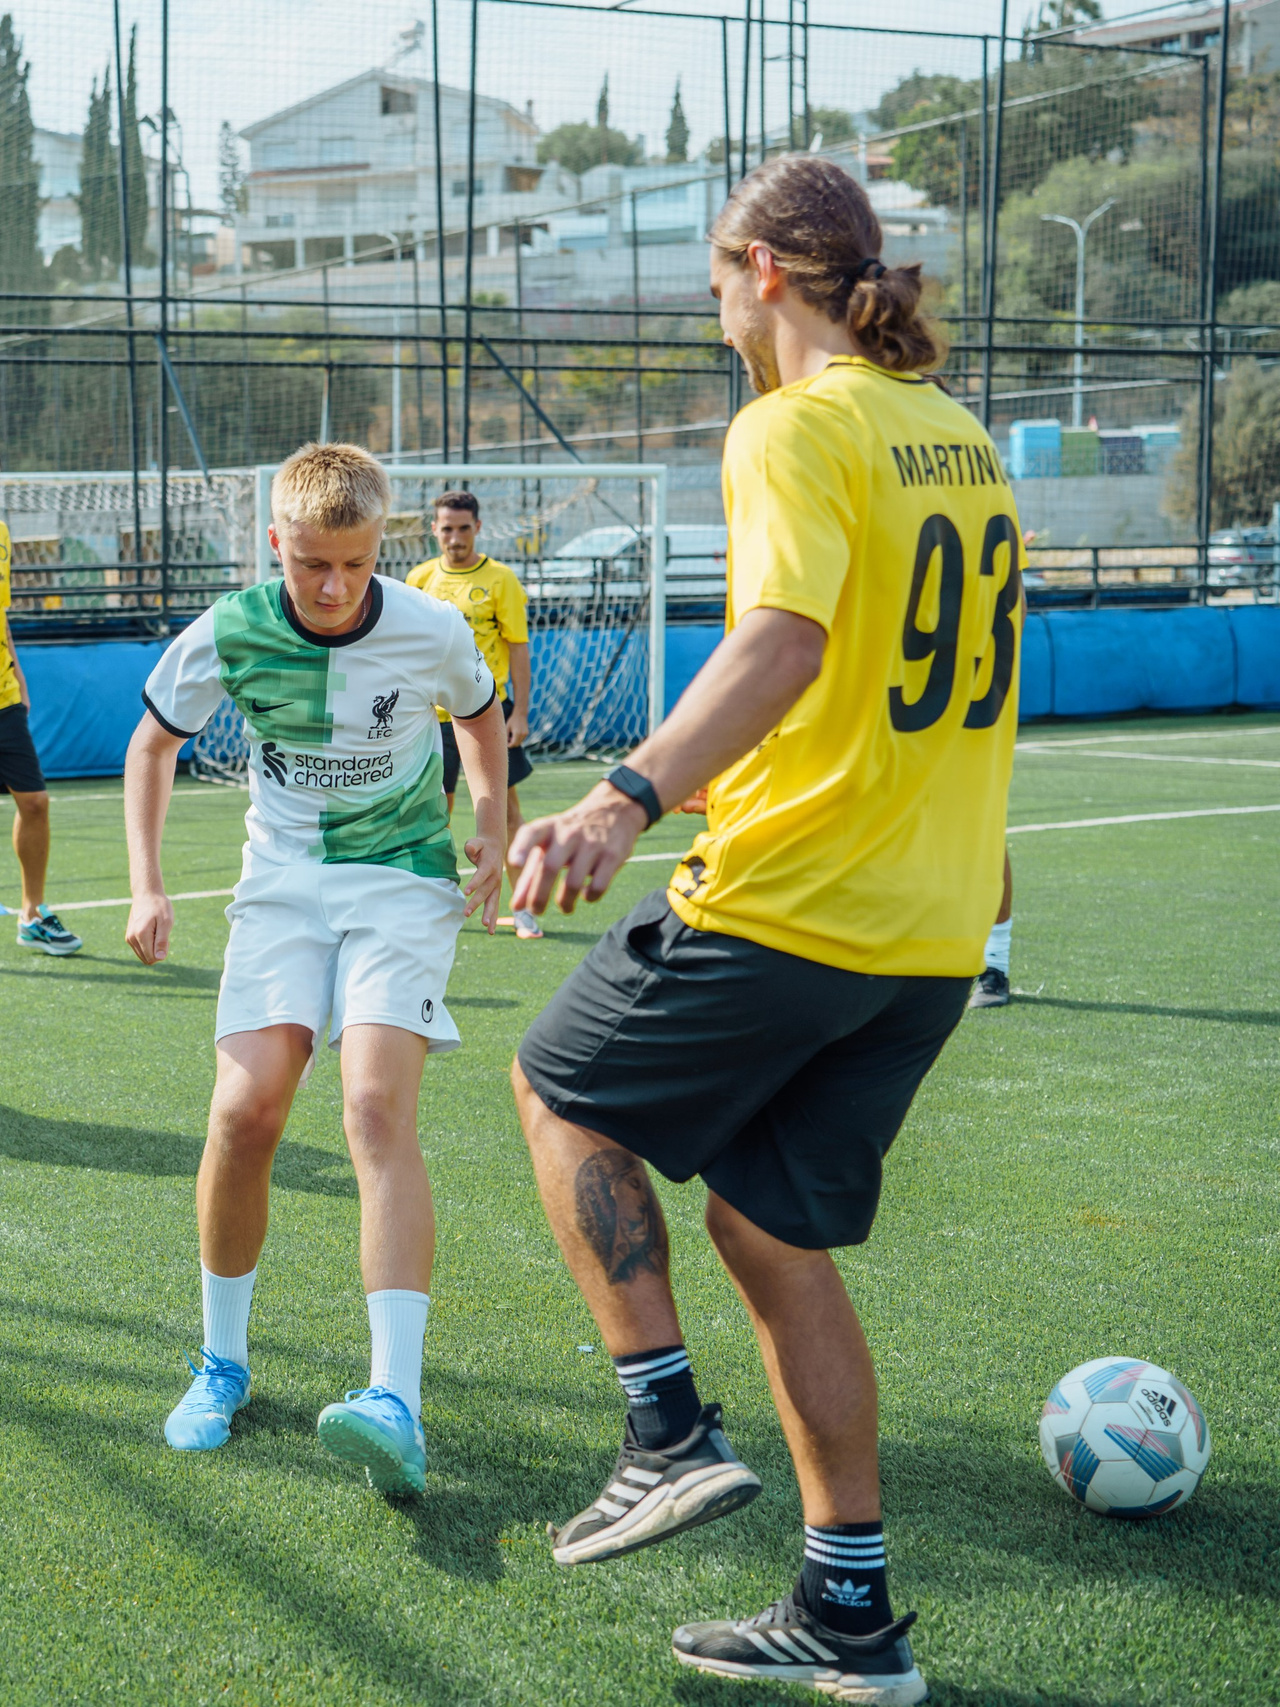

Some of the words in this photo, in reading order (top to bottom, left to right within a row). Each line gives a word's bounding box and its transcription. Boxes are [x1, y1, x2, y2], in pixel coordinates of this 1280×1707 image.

[888, 513, 1018, 732] 93
[294, 750, 392, 771] standard
[293, 762, 393, 788] chartered
[1141, 1388, 1171, 1427] adidas
[821, 1592, 872, 1607] adidas
